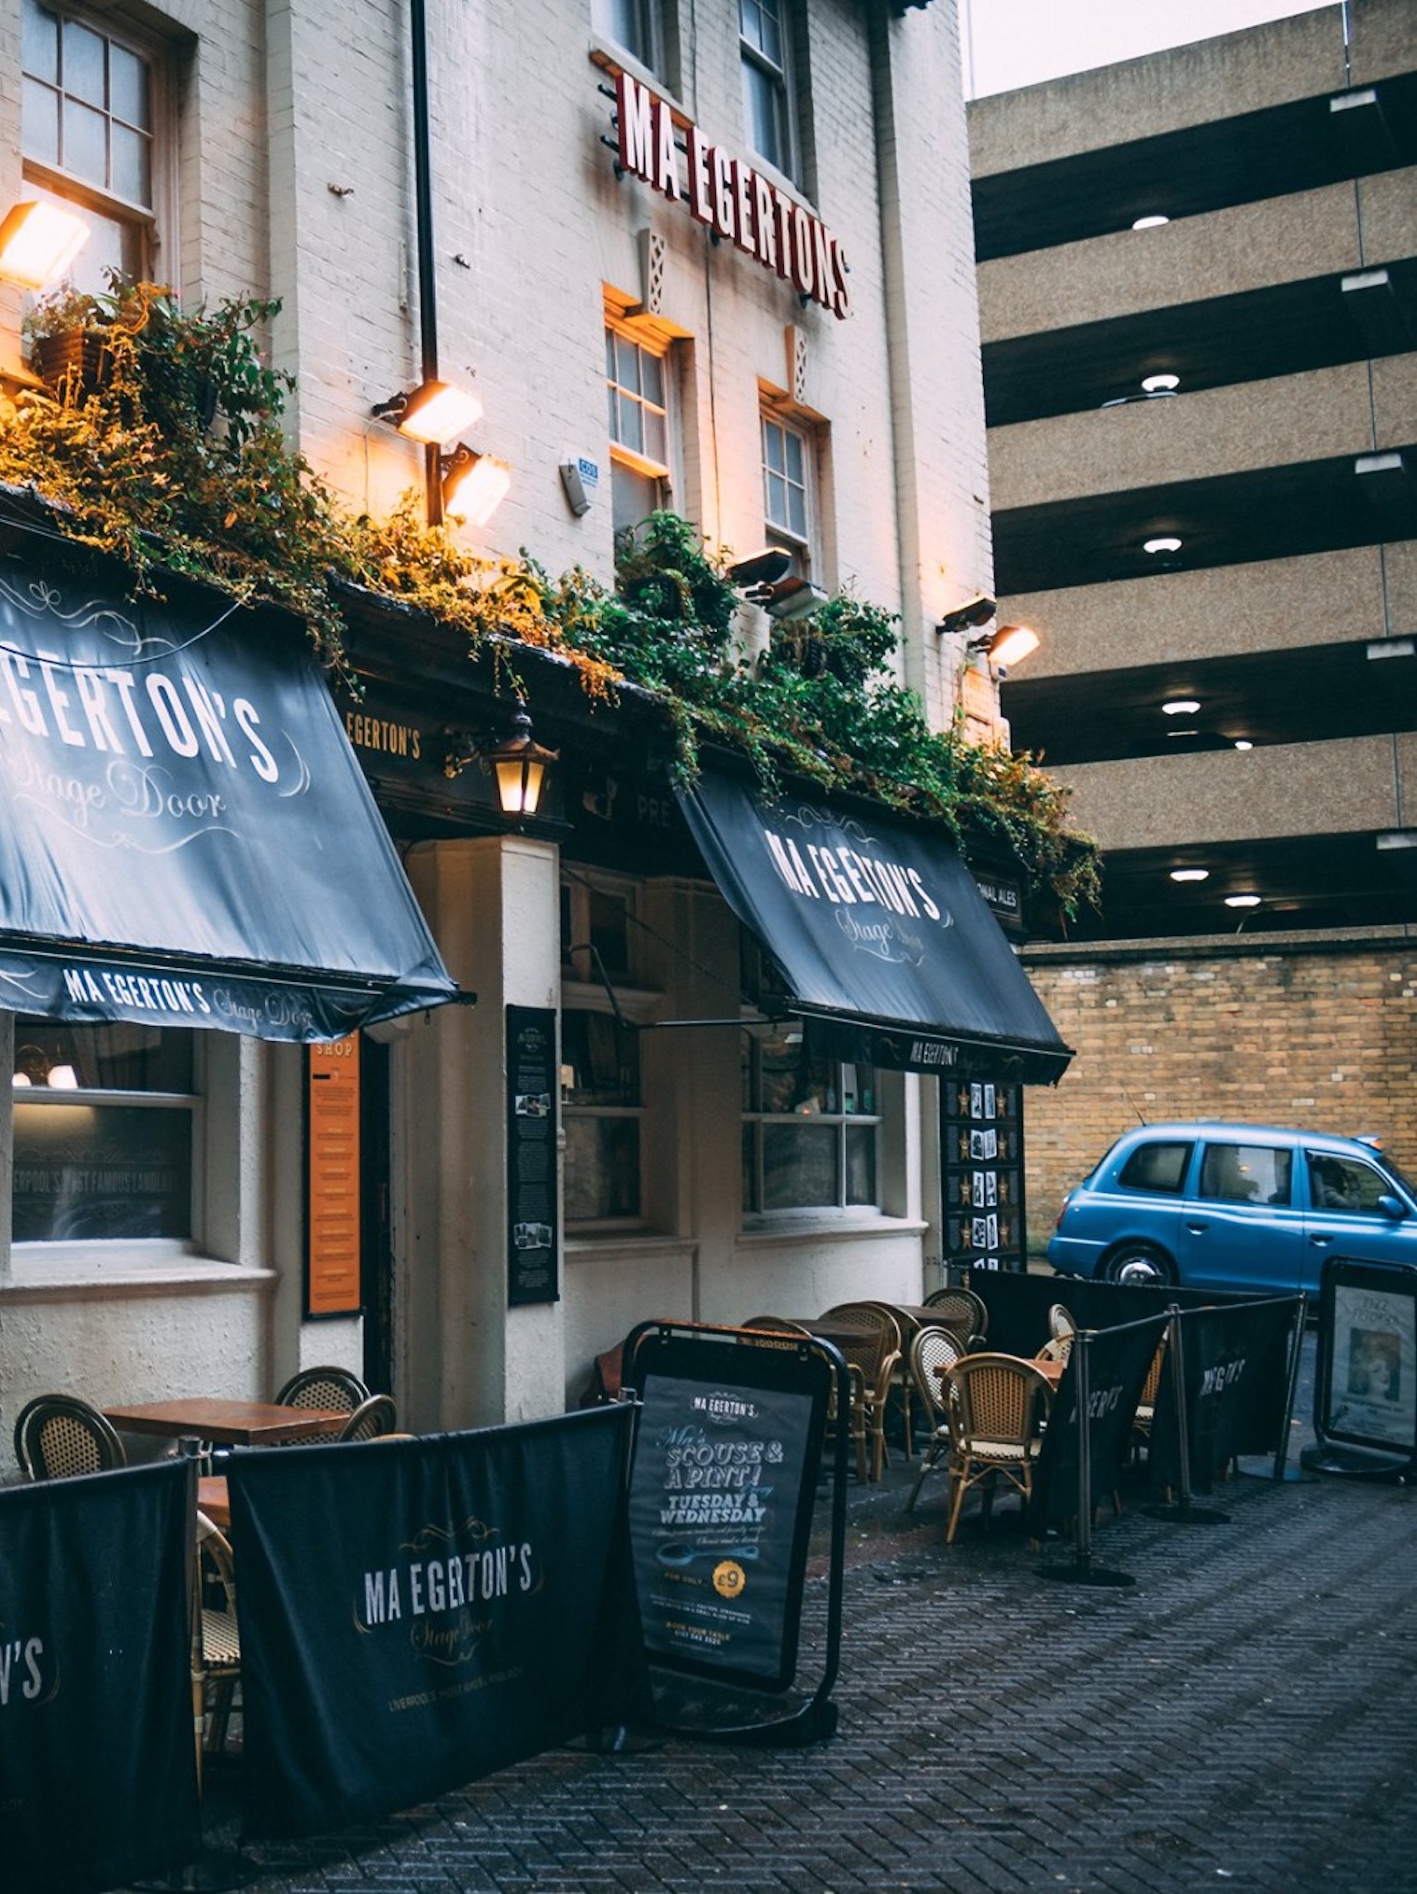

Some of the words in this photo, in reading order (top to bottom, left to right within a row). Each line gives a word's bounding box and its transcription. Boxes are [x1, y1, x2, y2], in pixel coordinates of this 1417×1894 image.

[616, 72, 680, 201] MA
[346, 711, 421, 761] EGERTON'S
[105, 759, 226, 819] Door
[764, 829, 821, 899] MA
[998, 888, 1017, 908] ALES
[835, 906, 893, 956] Stage
[61, 968, 100, 1003] MA
[105, 969, 212, 1015] EGERTON'S
[213, 988, 263, 1035] Stage
[316, 1042, 353, 1057] SHOP
[91, 1171, 131, 1194] FAMOUS
[693, 1396, 707, 1411] MA
[708, 1398, 755, 1417] EGERTON'S
[665, 1441, 765, 1468] SCOUSE
[765, 1440, 784, 1464] &
[663, 1466, 683, 1490] A
[668, 1493, 746, 1511] TUESDAY
[747, 1493, 759, 1508] &
[659, 1507, 767, 1525] WEDNESDAY
[364, 1567, 402, 1625] MA
[409, 1542, 532, 1616] EGERTON'S
[717, 1569, 740, 1589] £9
